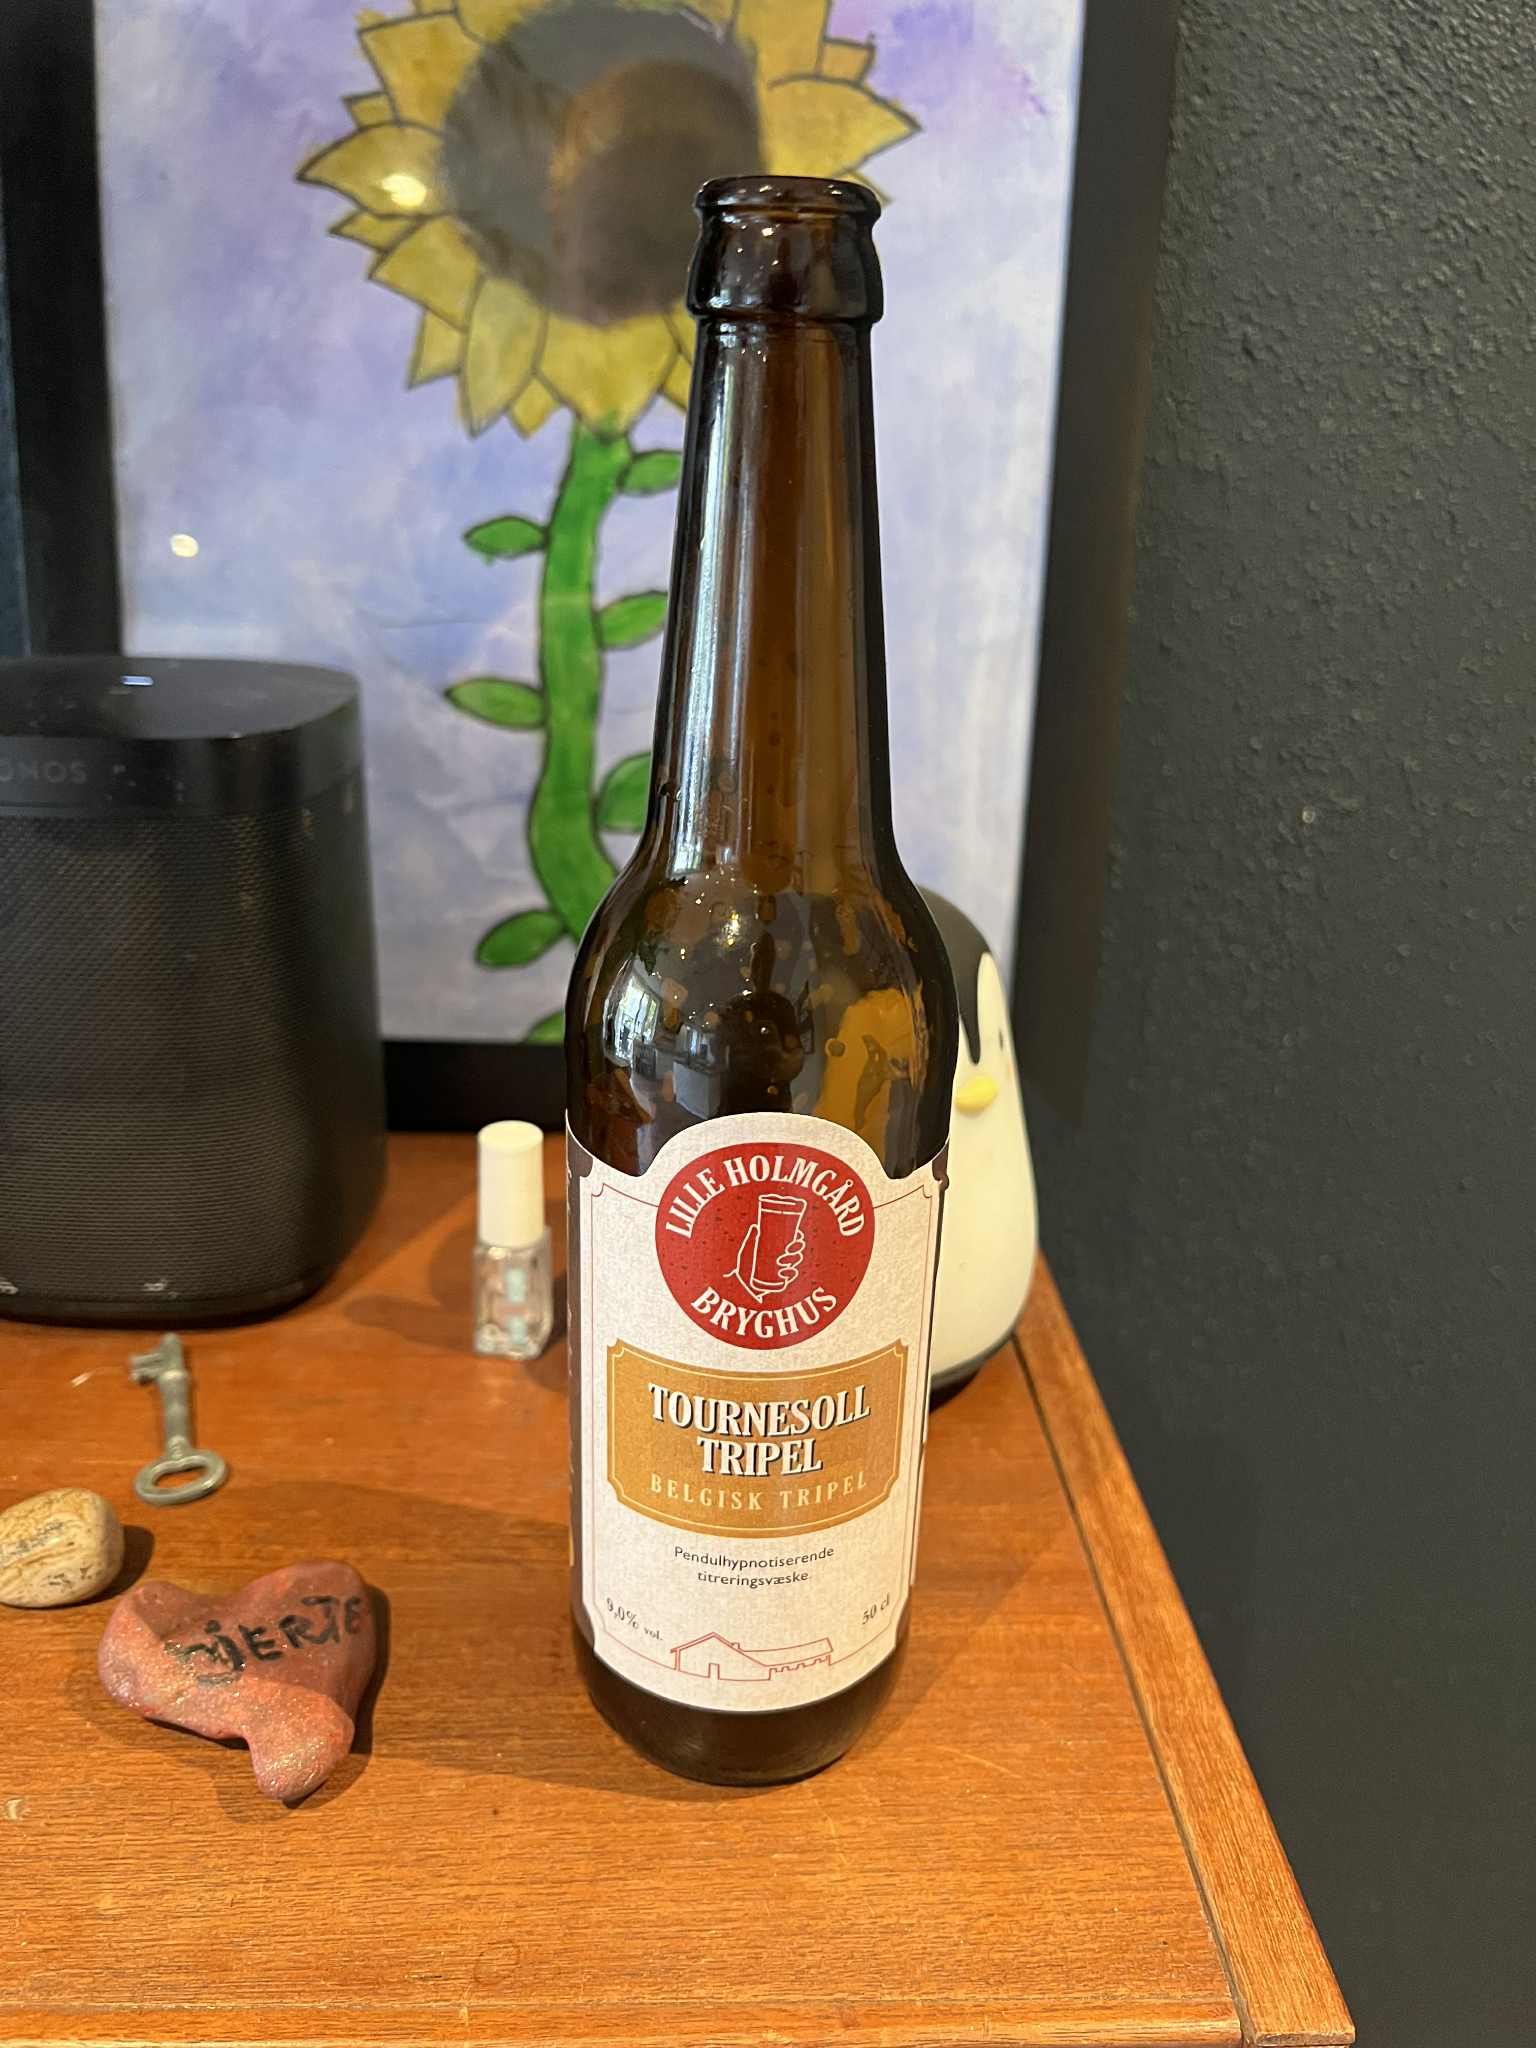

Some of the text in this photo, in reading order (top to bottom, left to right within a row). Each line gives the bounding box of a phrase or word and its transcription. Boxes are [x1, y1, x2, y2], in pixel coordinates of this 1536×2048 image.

[665, 1155, 865, 1238] LILLE HOLMGÅRD
[690, 1286, 837, 1339] BRYGHUS
[648, 1382, 872, 1437] TOURNESOLL
[696, 1435, 823, 1477] TRIPEL
[650, 1471, 867, 1511] BELGISK TRIPEL
[674, 1546, 835, 1571] Pendulhypnotiserende
[697, 1571, 809, 1588] titreringsvæske
[606, 1597, 639, 1630] 9,0%
[862, 1604, 877, 1625] 50
